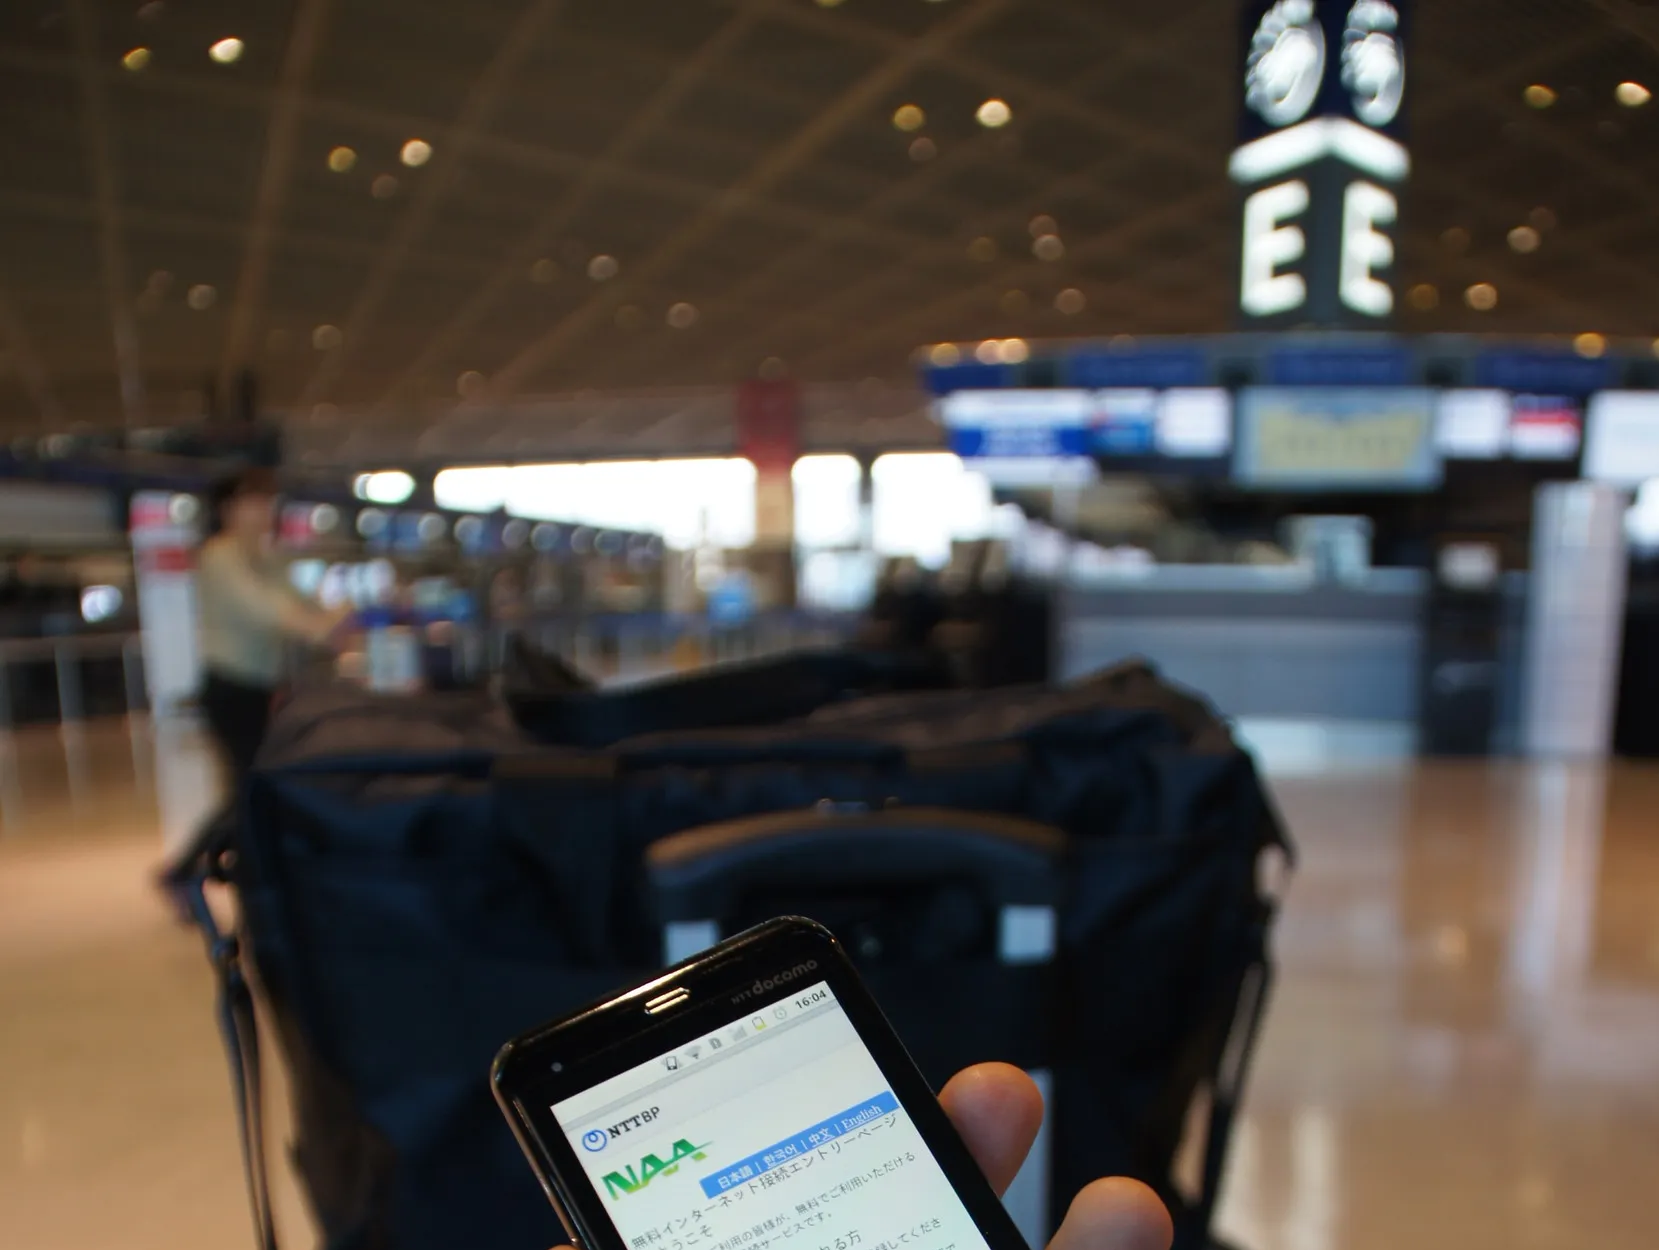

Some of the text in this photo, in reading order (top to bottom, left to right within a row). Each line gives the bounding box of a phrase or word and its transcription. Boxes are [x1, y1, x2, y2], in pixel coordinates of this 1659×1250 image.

[1240, 180, 1310, 316] E
[1340, 180, 1398, 316] E
[748, 955, 819, 996] docomo
[794, 989, 827, 1010] 16:04
[606, 1105, 662, 1139] NTT BP
[762, 1142, 800, 1167] 한국어
[806, 1126, 833, 1146] 中文
[840, 1102, 883, 1130] English
[600, 1132, 709, 1202] NAA
